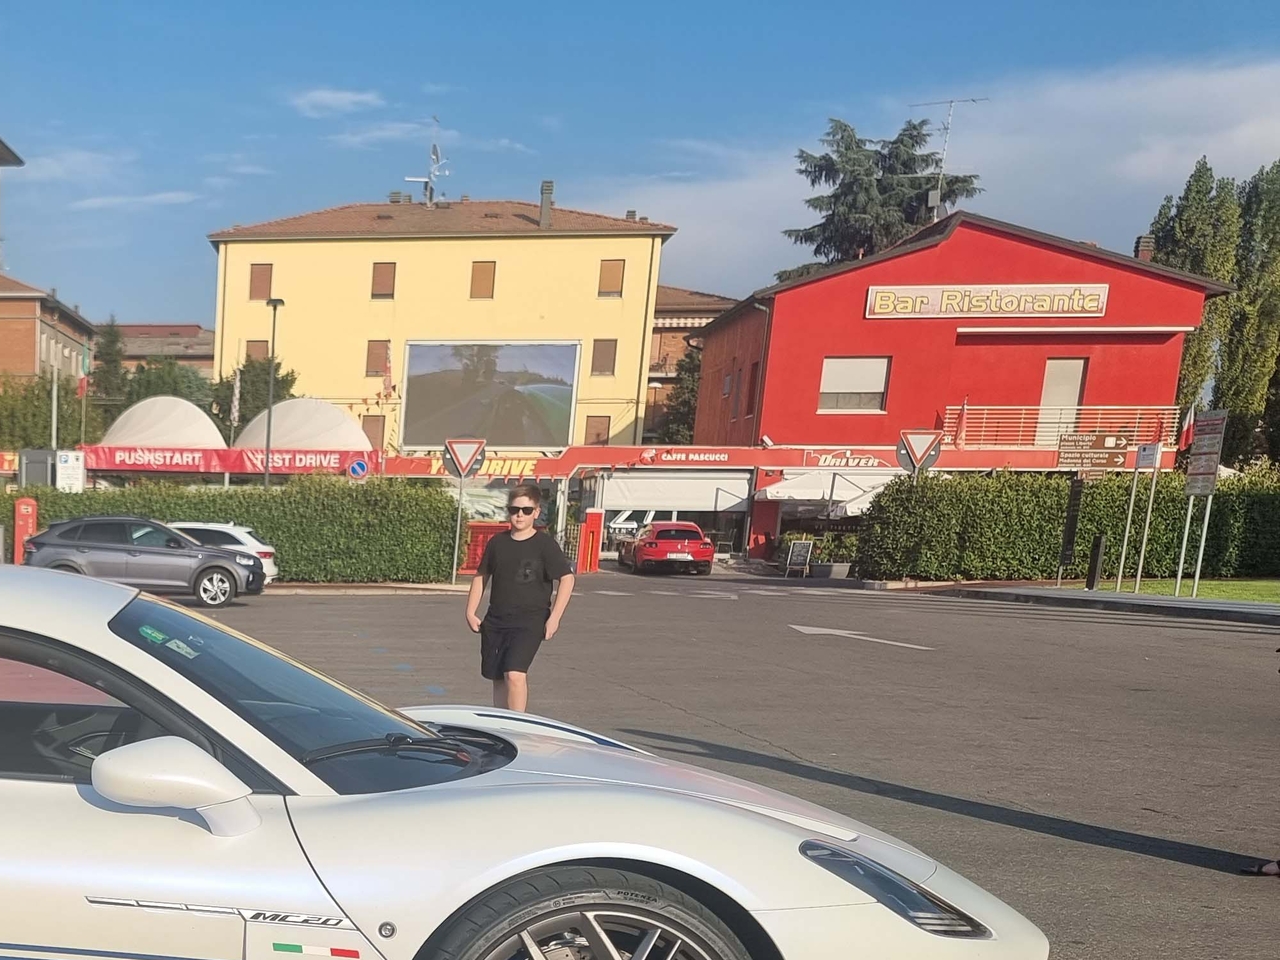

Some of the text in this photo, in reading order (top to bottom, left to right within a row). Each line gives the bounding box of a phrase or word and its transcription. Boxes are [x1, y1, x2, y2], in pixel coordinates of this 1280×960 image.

[873, 287, 1102, 315] Bar Ristorante
[255, 453, 340, 467] TEST DRIVE
[688, 452, 729, 462] PASCUCCI
[616, 890, 658, 903] POTENZA
[249, 911, 343, 927] MC20
